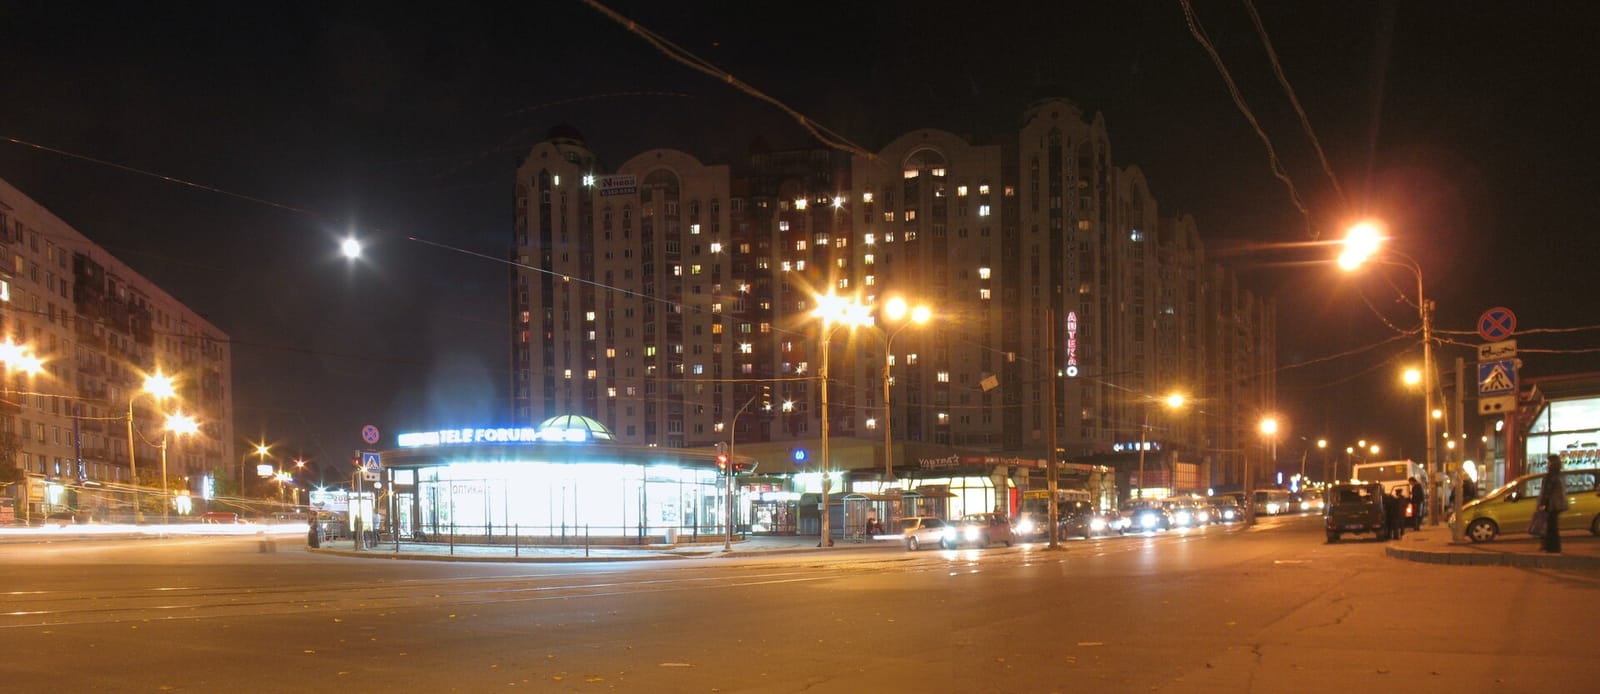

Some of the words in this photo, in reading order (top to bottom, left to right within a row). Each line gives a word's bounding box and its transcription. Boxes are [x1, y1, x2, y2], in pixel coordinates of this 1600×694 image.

[1067, 311, 1077, 366] АПТЕКА
[440, 429, 473, 443] TELE
[475, 428, 536, 442] FORUM
